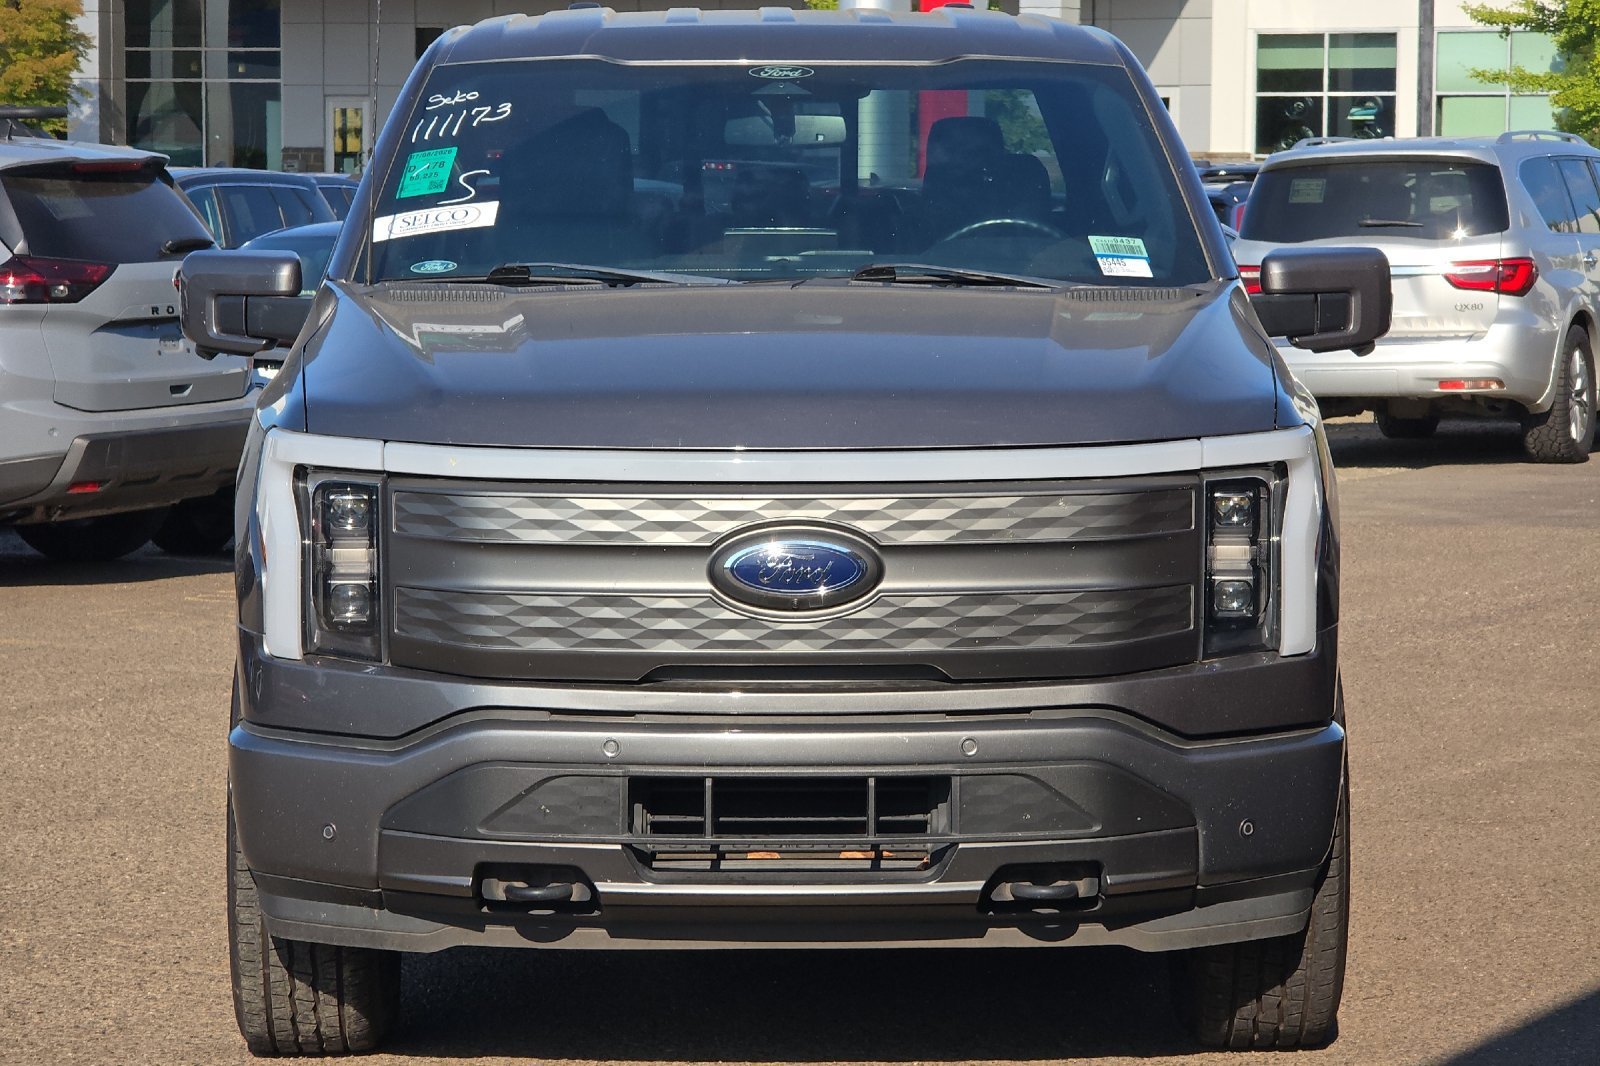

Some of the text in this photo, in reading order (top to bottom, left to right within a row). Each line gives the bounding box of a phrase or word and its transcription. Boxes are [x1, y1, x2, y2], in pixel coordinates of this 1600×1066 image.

[760, 67, 803, 77] Ford
[411, 102, 512, 143] 111173
[400, 208, 469, 229] SELCO
[1454, 303, 1484, 312] QX80
[758, 551, 835, 585] Ford
